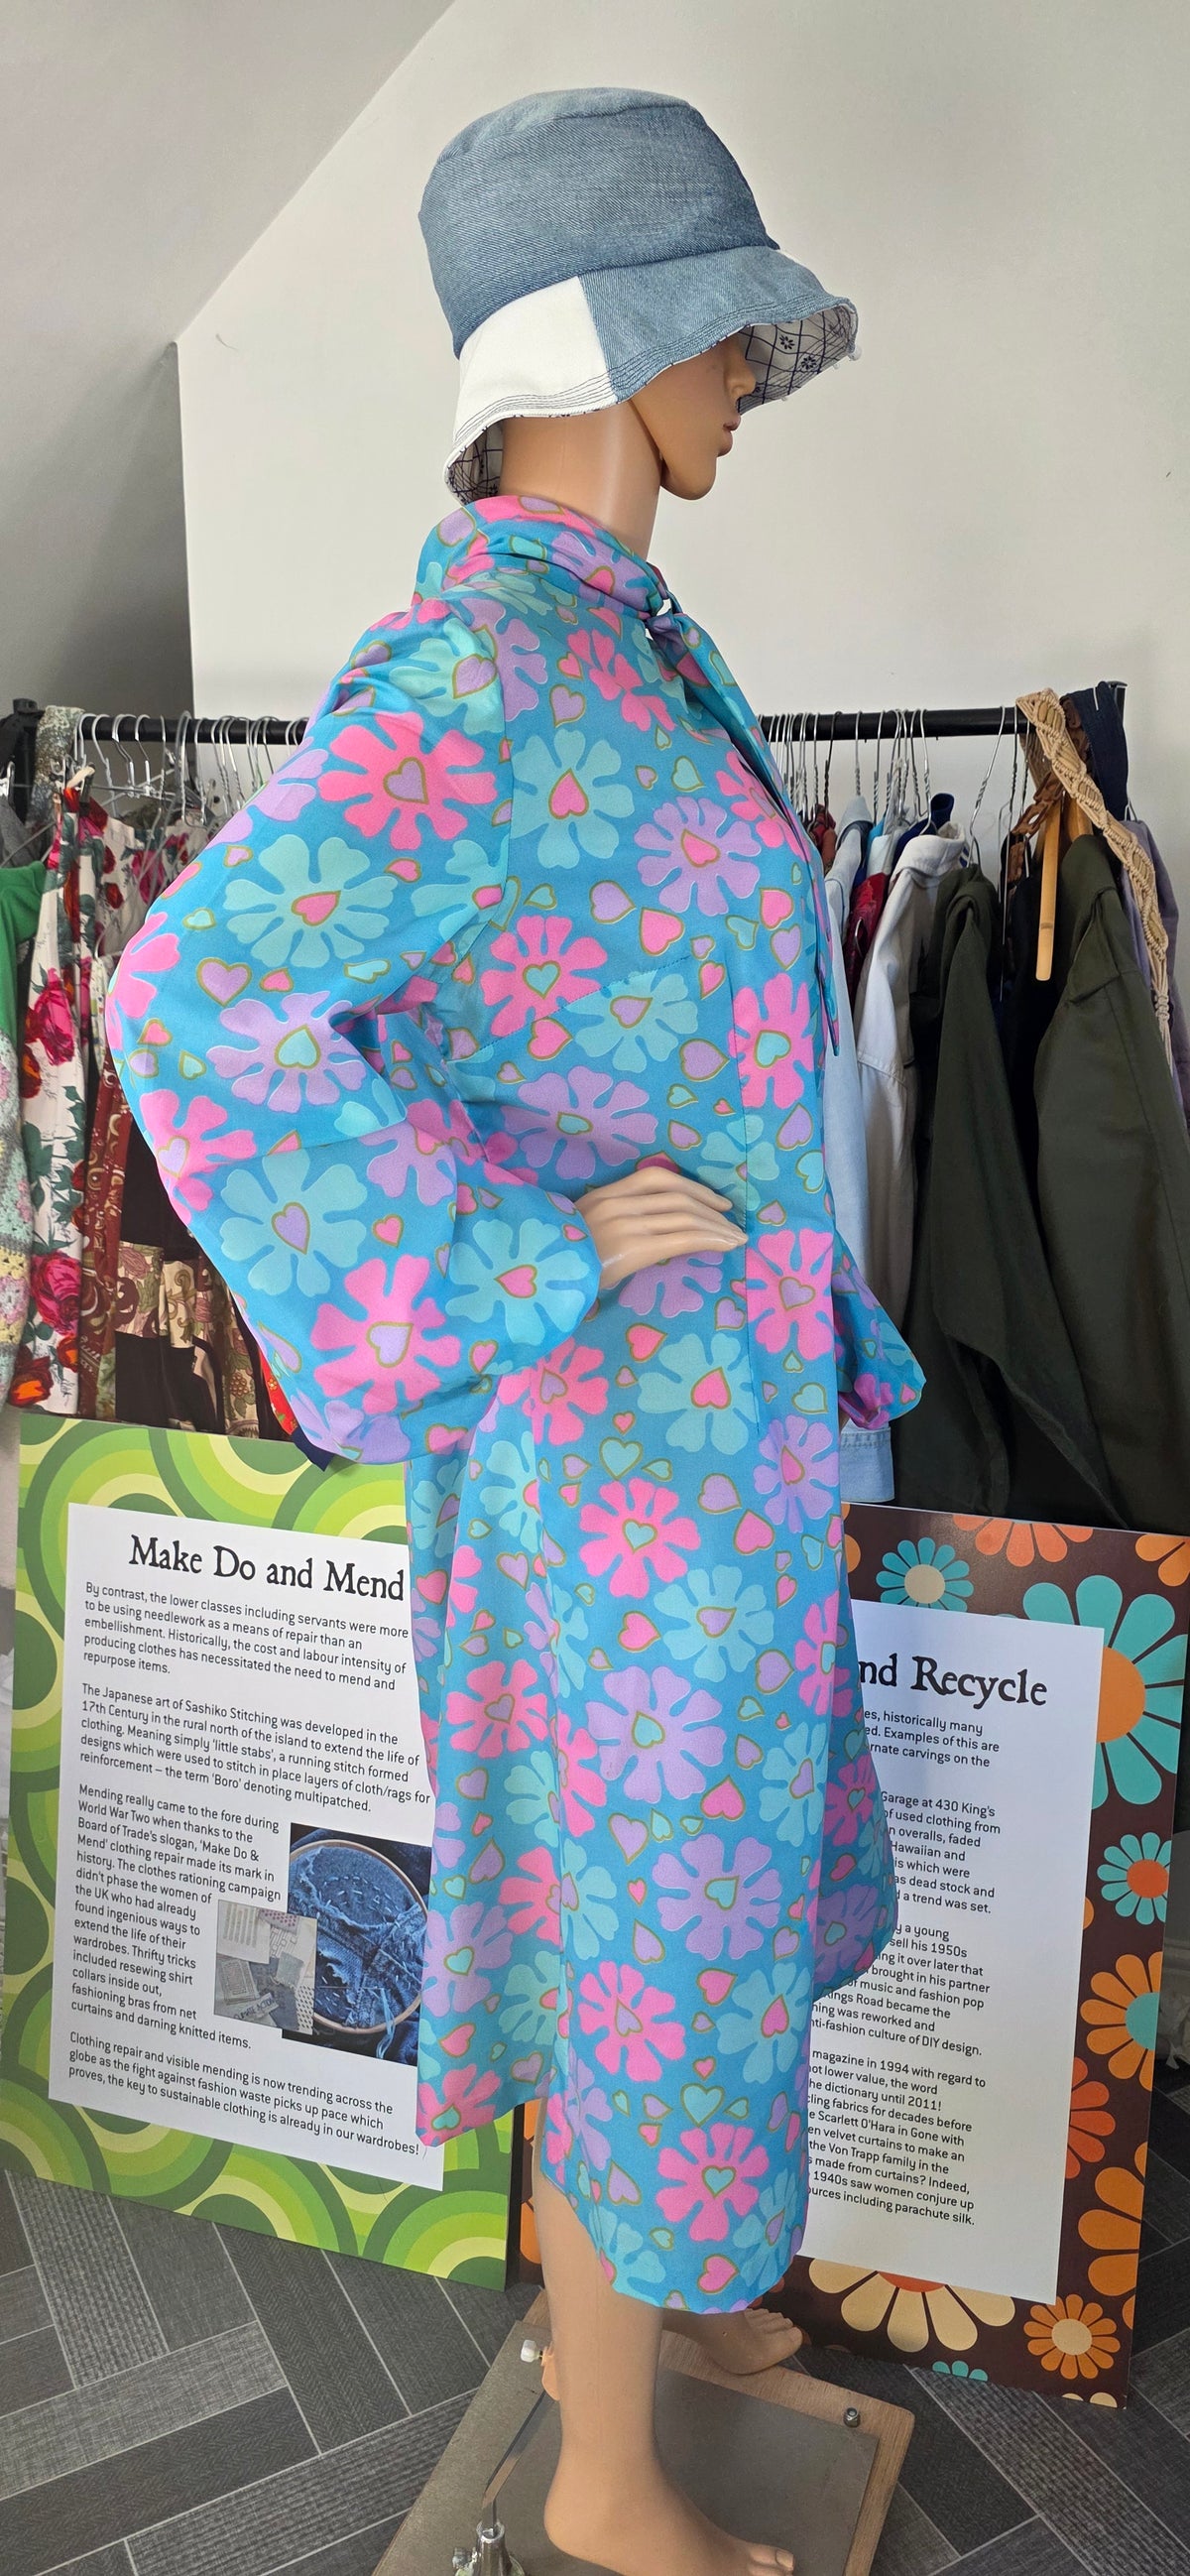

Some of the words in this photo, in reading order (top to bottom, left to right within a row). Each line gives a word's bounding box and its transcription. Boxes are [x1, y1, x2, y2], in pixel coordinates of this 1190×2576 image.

[128, 1533, 202, 1574] Make
[212, 1544, 256, 1581] Do
[266, 1556, 312, 1589] and
[322, 1559, 404, 1601] Mend
[84, 1600, 95, 1611] to
[97, 1600, 110, 1613] be
[112, 1604, 142, 1621] using
[144, 1610, 206, 1628] needlework
[207, 1619, 221, 1630] as
[222, 1621, 230, 1631] a
[232, 1622, 270, 1637] means
[272, 1626, 284, 1639] of
[285, 1630, 318, 1645] repair
[319, 1633, 345, 1648] than
[347, 1639, 362, 1651] an
[85, 1581, 99, 1598] By
[101, 1586, 148, 1603] contrast,
[149, 1591, 167, 1604] the
[169, 1593, 198, 1609] lower
[200, 1599, 242, 1615] classes
[244, 1604, 296, 1626] including
[297, 1614, 346, 1630] servants
[348, 1621, 377, 1634] were
[379, 1626, 409, 1639] more
[83, 1635, 136, 1655] producing
[137, 1641, 177, 1657] clothes
[178, 1647, 198, 1661] has
[200, 1653, 271, 1671] necessitated
[273, 1661, 292, 1675] the
[294, 1666, 322, 1679] need
[324, 1669, 336, 1681] to
[338, 1673, 371, 1687] mend
[373, 1678, 396, 1690] and
[83, 1652, 136, 1668] repurpose
[138, 1657, 170, 1673] items.
[84, 1617, 166, 1639] embellishment.
[168, 1628, 231, 1652] Historically,
[232, 1638, 251, 1652] the
[253, 1643, 278, 1656] cost
[279, 1647, 300, 1658] and
[302, 1648, 339, 1664] labour
[340, 1653, 392, 1676] intensity
[394, 1661, 407, 1674] of
[858, 1652, 897, 1687] nd
[909, 1655, 1047, 1710] Recycle
[81, 1682, 100, 1696] The
[101, 1686, 153, 1705] Japanese
[155, 1697, 170, 1708] art
[172, 1698, 183, 1710] of
[184, 1699, 227, 1718] Sashiko
[229, 1706, 278, 1729] Stitching
[280, 1717, 302, 1730] was
[304, 1719, 364, 1741] developed
[366, 1728, 377, 1742] in
[379, 1731, 398, 1745] the
[81, 1699, 106, 1714] 17th
[108, 1703, 149, 1725] Century
[151, 1710, 161, 1724] in
[163, 1713, 180, 1727] the
[182, 1719, 207, 1732] rural
[209, 1723, 239, 1737] north
[240, 1727, 253, 1739] of
[253, 1728, 272, 1742] the
[274, 1731, 308, 1748] island
[309, 1739, 321, 1751] to
[323, 1742, 363, 1758] extend
[365, 1746, 384, 1761] the
[387, 1749, 405, 1765] life
[407, 1754, 419, 1767] of
[883, 1709, 946, 1732] historically
[948, 1721, 983, 1737] many
[883, 1726, 939, 1745] Examples
[942, 1735, 955, 1747] of
[955, 1736, 979, 1750] this
[980, 1742, 1000, 1752] are
[901, 1747, 951, 1765] carvings
[953, 1755, 968, 1765] on
[970, 1755, 990, 1768] the
[78, 1782, 123, 1805] Mending
[125, 1794, 155, 1811] really
[156, 1799, 185, 1813] came
[187, 1804, 198, 1816] to
[199, 1806, 218, 1820] the
[220, 1808, 242, 1824] fore
[244, 1813, 279, 1834] during
[881, 1790, 919, 1809] Garage
[921, 1798, 933, 1808] at
[934, 1798, 959, 1812] 430
[961, 1801, 996, 1819] King's
[894, 1810, 923, 1823] used
[925, 1813, 972, 1833] clothing
[974, 1819, 1001, 1834] from
[897, 1827, 945, 1844] overalls,
[948, 1832, 981, 1847] faded
[76, 1849, 115, 1871] history.
[116, 1857, 136, 1872] The
[137, 1862, 177, 1880] clothes
[178, 1872, 225, 1894] rationing
[227, 1882, 281, 1902] campaign
[74, 1883, 92, 1897] the
[94, 1887, 109, 1901] UK
[110, 1892, 133, 1905] who
[134, 1895, 155, 1909] had
[156, 1900, 196, 1921] already
[70, 2001, 113, 2018] curtains
[115, 2011, 135, 2023] and
[137, 2014, 177, 2035] darning
[178, 2022, 216, 2041] knitted
[218, 2030, 251, 2049] items.
[811, 2049, 865, 2066] magazine
[866, 2056, 877, 2069] in
[880, 2059, 909, 2074] 1994
[910, 2066, 934, 2079] with
[936, 2071, 973, 2085] regard
[974, 2077, 986, 2088] to
[68, 2066, 105, 2084] proves,
[107, 2073, 124, 2087] the
[126, 2076, 146, 2095] key
[147, 2083, 158, 2095] to
[160, 2087, 221, 2110] sustainable
[222, 2100, 266, 2124] clothing
[268, 2109, 278, 2123] is
[279, 2113, 320, 2136] already
[322, 2122, 333, 2136] in
[335, 2128, 355, 2140] our
[355, 2132, 418, 2155] wardrobes!
[831, 2097, 869, 2114] fabrics
[871, 2104, 887, 2117] for
[887, 2107, 934, 2126] decades
[936, 2115, 972, 2132] before
[808, 2139, 826, 2151] the
[828, 2142, 849, 2156] Von
[850, 2146, 880, 2164] Trapp
[882, 2151, 916, 2171] family
[917, 2158, 929, 2171] in
[930, 2161, 949, 2174] the
[814, 2157, 846, 2170] made
[847, 2160, 873, 2175] from
[874, 2168, 926, 2185] curtains?
[928, 2175, 970, 2195] Indeed,
[813, 2167, 848, 2186] 1940s
[850, 2179, 873, 2190] saw
[873, 2183, 914, 2199] women
[915, 2191, 958, 2207] conjure
[959, 2199, 974, 2213] up
[843, 2190, 893, 2213] including
[894, 2202, 950, 2220] parachute
[952, 2212, 974, 2225] silk.
